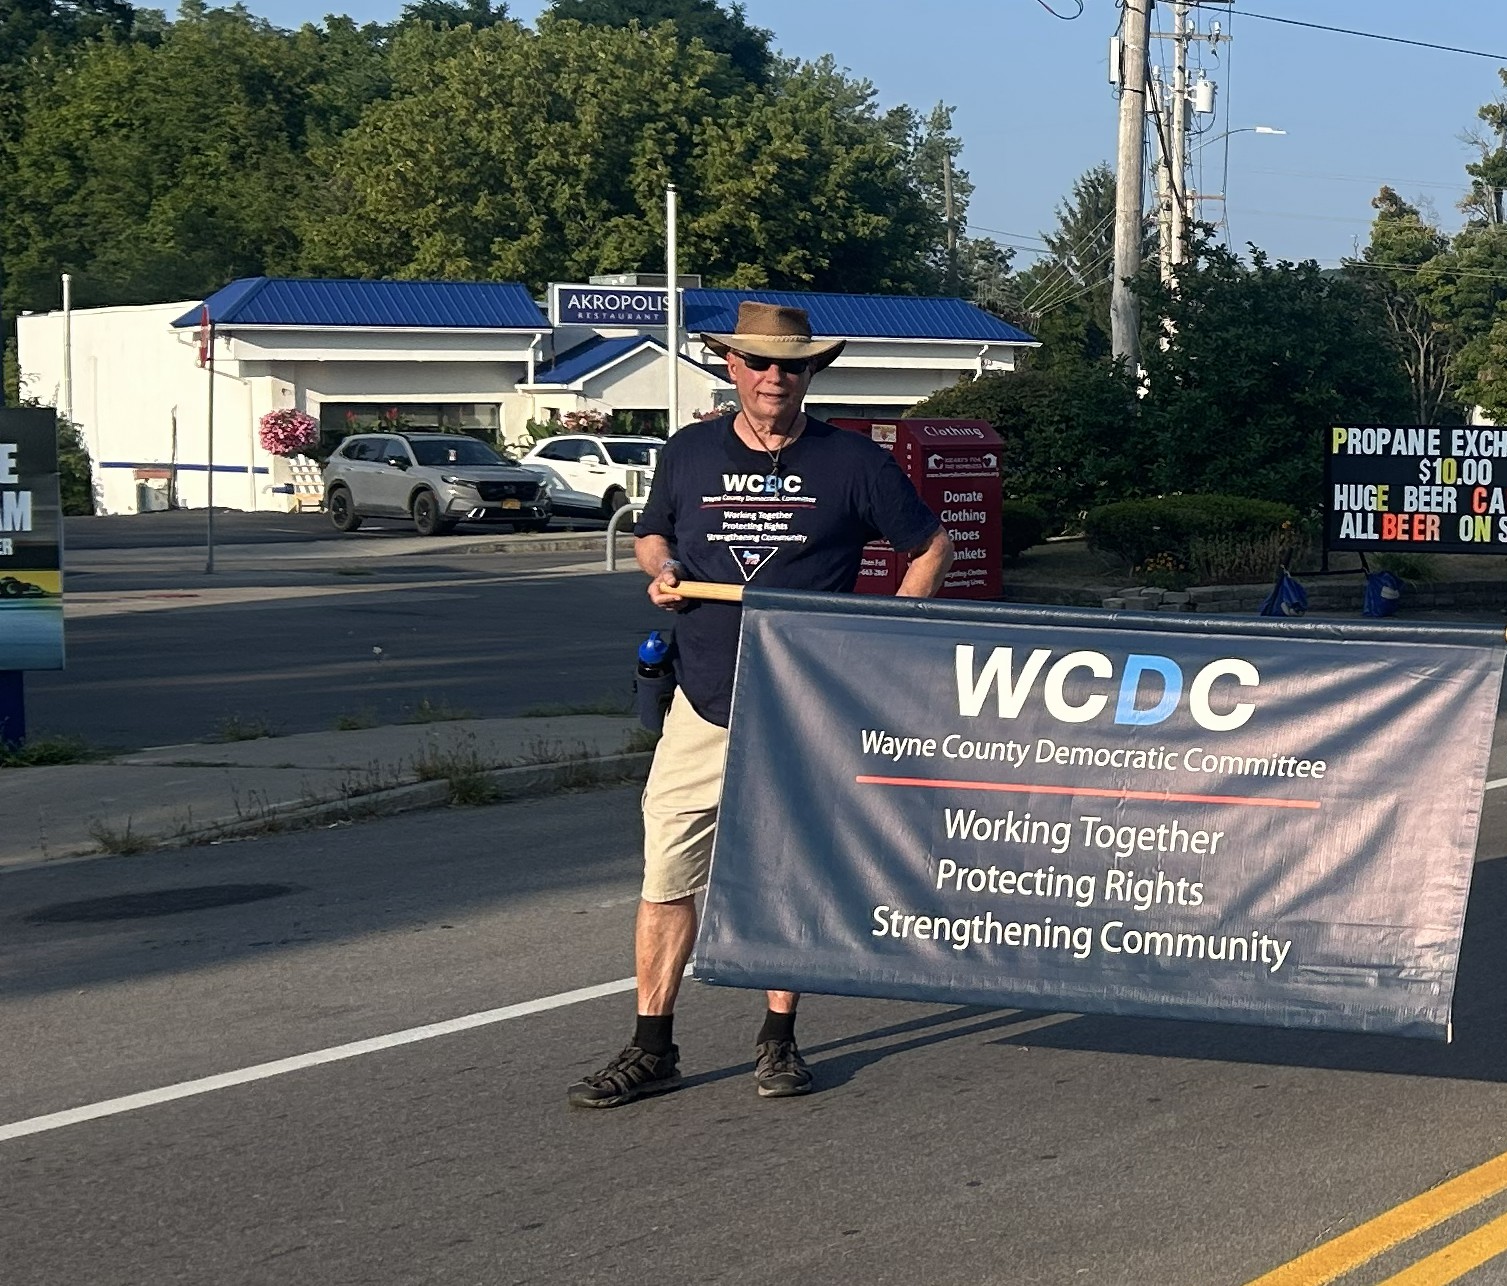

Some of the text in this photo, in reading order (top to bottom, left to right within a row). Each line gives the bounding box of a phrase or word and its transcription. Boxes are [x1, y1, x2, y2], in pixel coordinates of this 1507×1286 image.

[578, 312, 660, 320] RESTAURANT
[924, 426, 985, 439] Clothing
[1332, 428, 1441, 456] PROPANE
[722, 474, 802, 493] WCDC
[1419, 457, 1493, 486] $10.00
[944, 491, 983, 503] Donate
[1334, 484, 1390, 511] HUGE
[1404, 486, 1457, 513] BEER
[941, 509, 986, 524] Clothing
[1340, 513, 1379, 539] ALL
[1382, 513, 1441, 541] BEER
[1459, 515, 1492, 542] ON
[948, 529, 980, 541] Shoes
[953, 548, 987, 561] ankets
[955, 644, 1261, 732] WCDC
[861, 729, 1327, 779] Wayne County Democratic Committee
[945, 808, 1224, 859] Working Together
[936, 858, 1204, 911] Protecting Rights
[872, 905, 1292, 973] Strengthening Community
